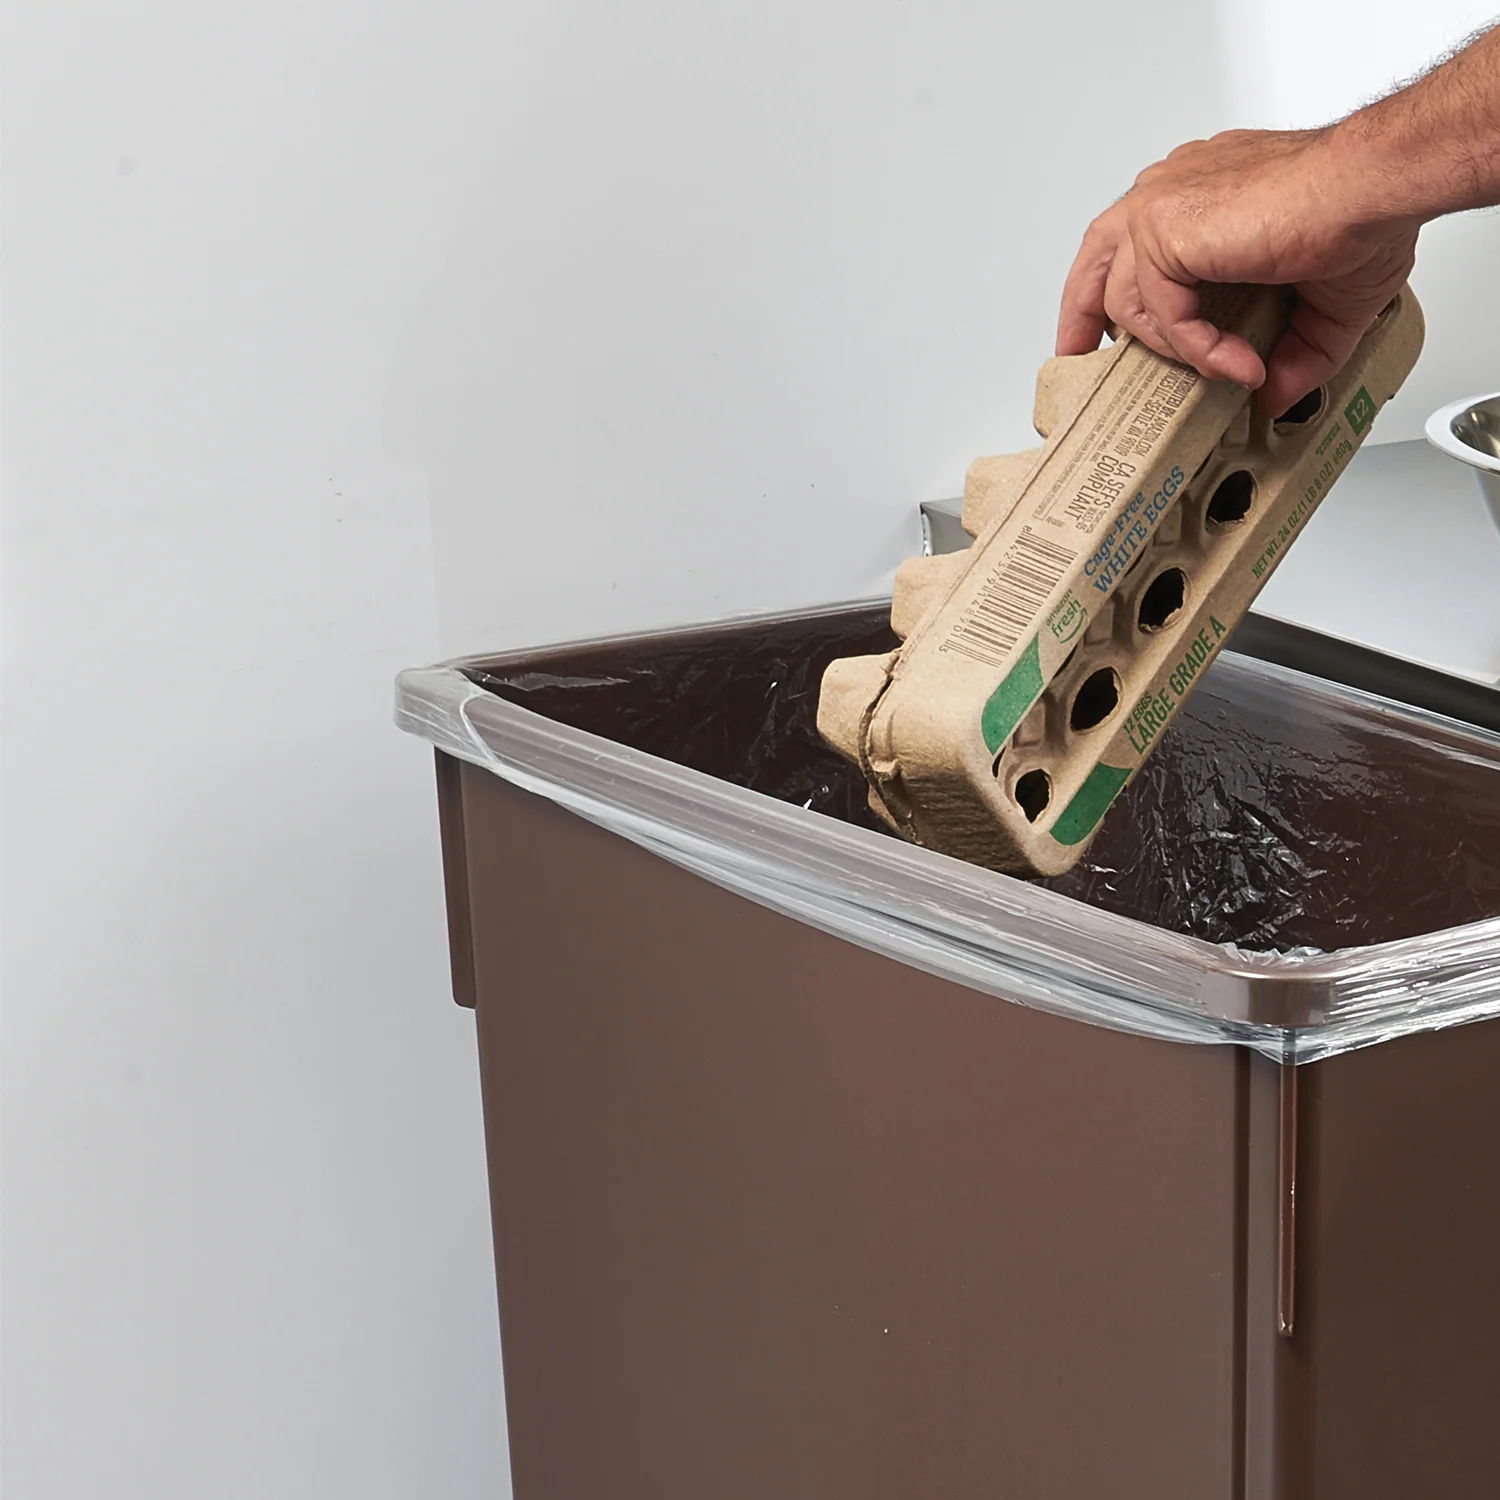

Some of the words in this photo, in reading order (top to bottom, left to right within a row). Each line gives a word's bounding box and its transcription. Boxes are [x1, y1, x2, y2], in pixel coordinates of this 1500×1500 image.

[1351, 398, 1370, 425] 12
[1130, 415, 1169, 457] AMAZON.COM
[1062, 453, 1120, 522] COMPLIANT
[1112, 461, 1137, 479] CA
[1092, 477, 1125, 510] SEFS
[1080, 489, 1147, 578] Cage-Free
[1092, 519, 1149, 593] WHITE
[1141, 463, 1186, 525] EGGS
[1250, 553, 1269, 578] NET
[1263, 538, 1281, 558] WT.
[1276, 524, 1291, 543] 24
[1286, 509, 1301, 529] OZ
[1304, 485, 1318, 503] LB
[1043, 587, 1074, 627] amazon
[1048, 597, 1083, 639] fresh
[1127, 686, 1176, 755] LARGE
[1165, 627, 1215, 696] GRADE
[1207, 614, 1228, 639] A
[1121, 717, 1135, 735] 12
[1130, 690, 1154, 721] EGGS
